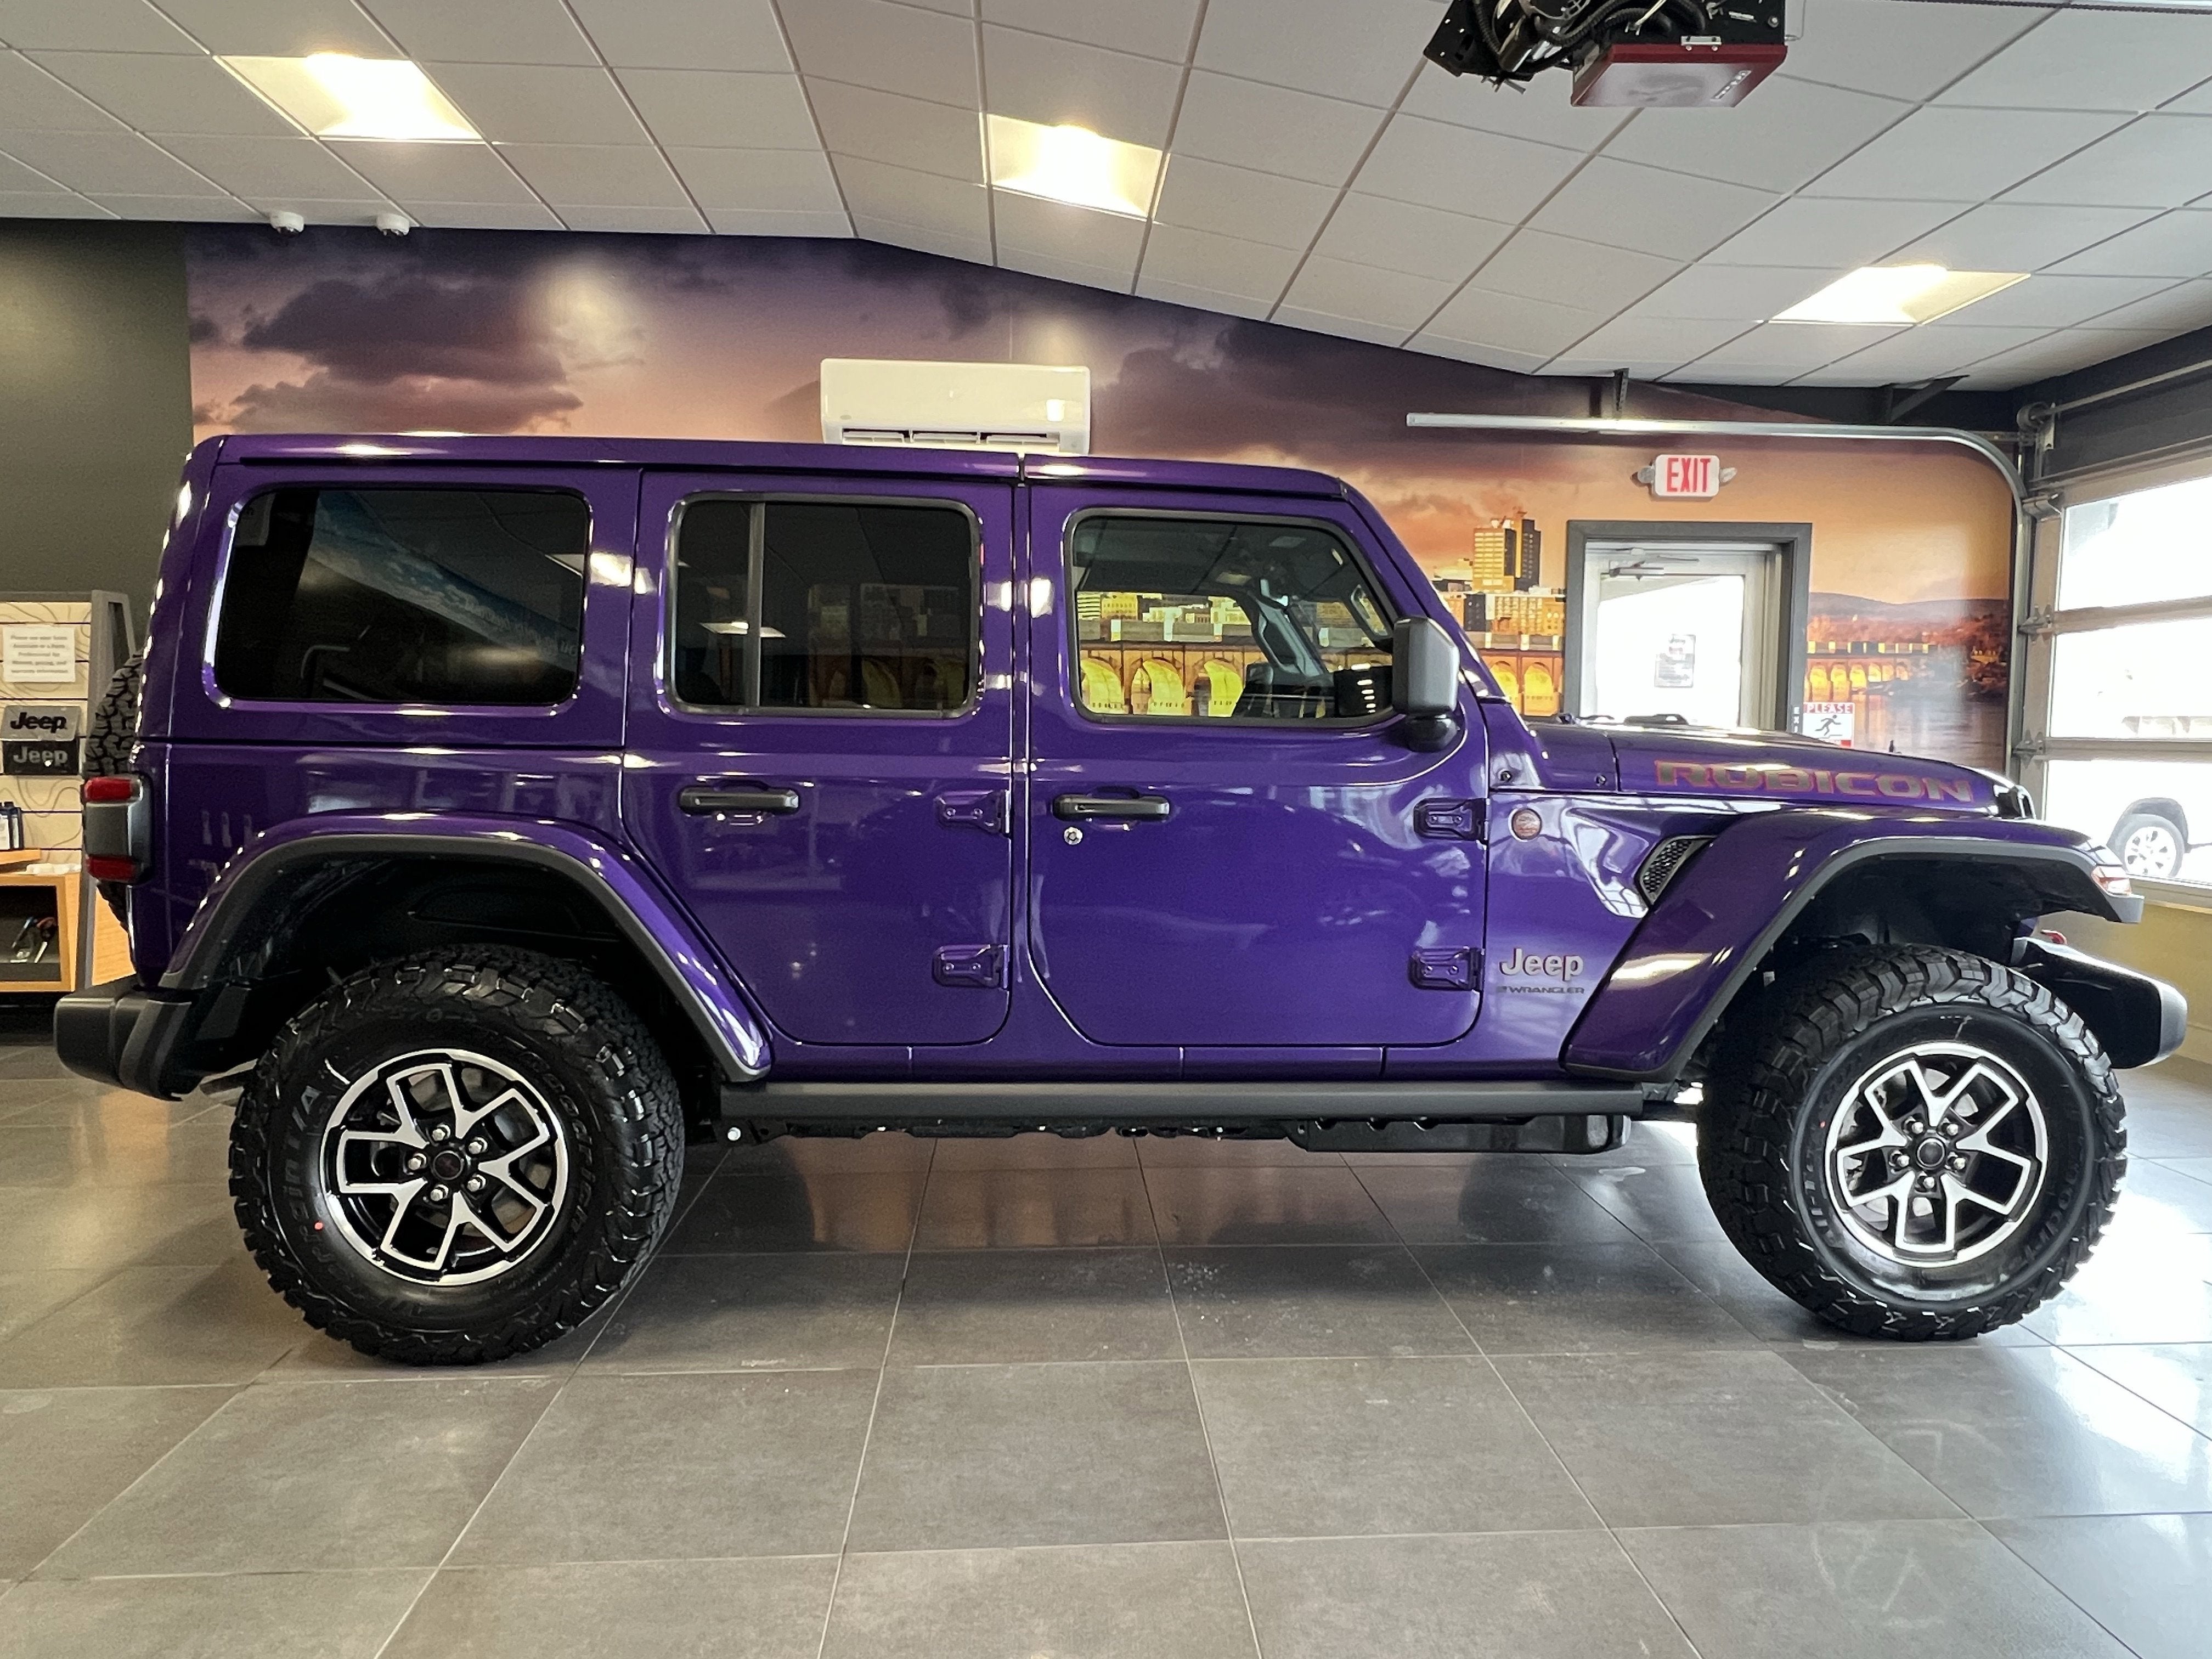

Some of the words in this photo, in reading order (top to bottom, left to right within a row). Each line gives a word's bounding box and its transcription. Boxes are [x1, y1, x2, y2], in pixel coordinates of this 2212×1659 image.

[1667, 457, 1711, 492] EXIT
[1806, 703, 1853, 714] PLEASE
[10, 712, 67, 733] Jeep
[13, 746, 68, 767] Jeep
[1654, 760, 1973, 803] RUBICON
[1499, 947, 1584, 981] Jeep
